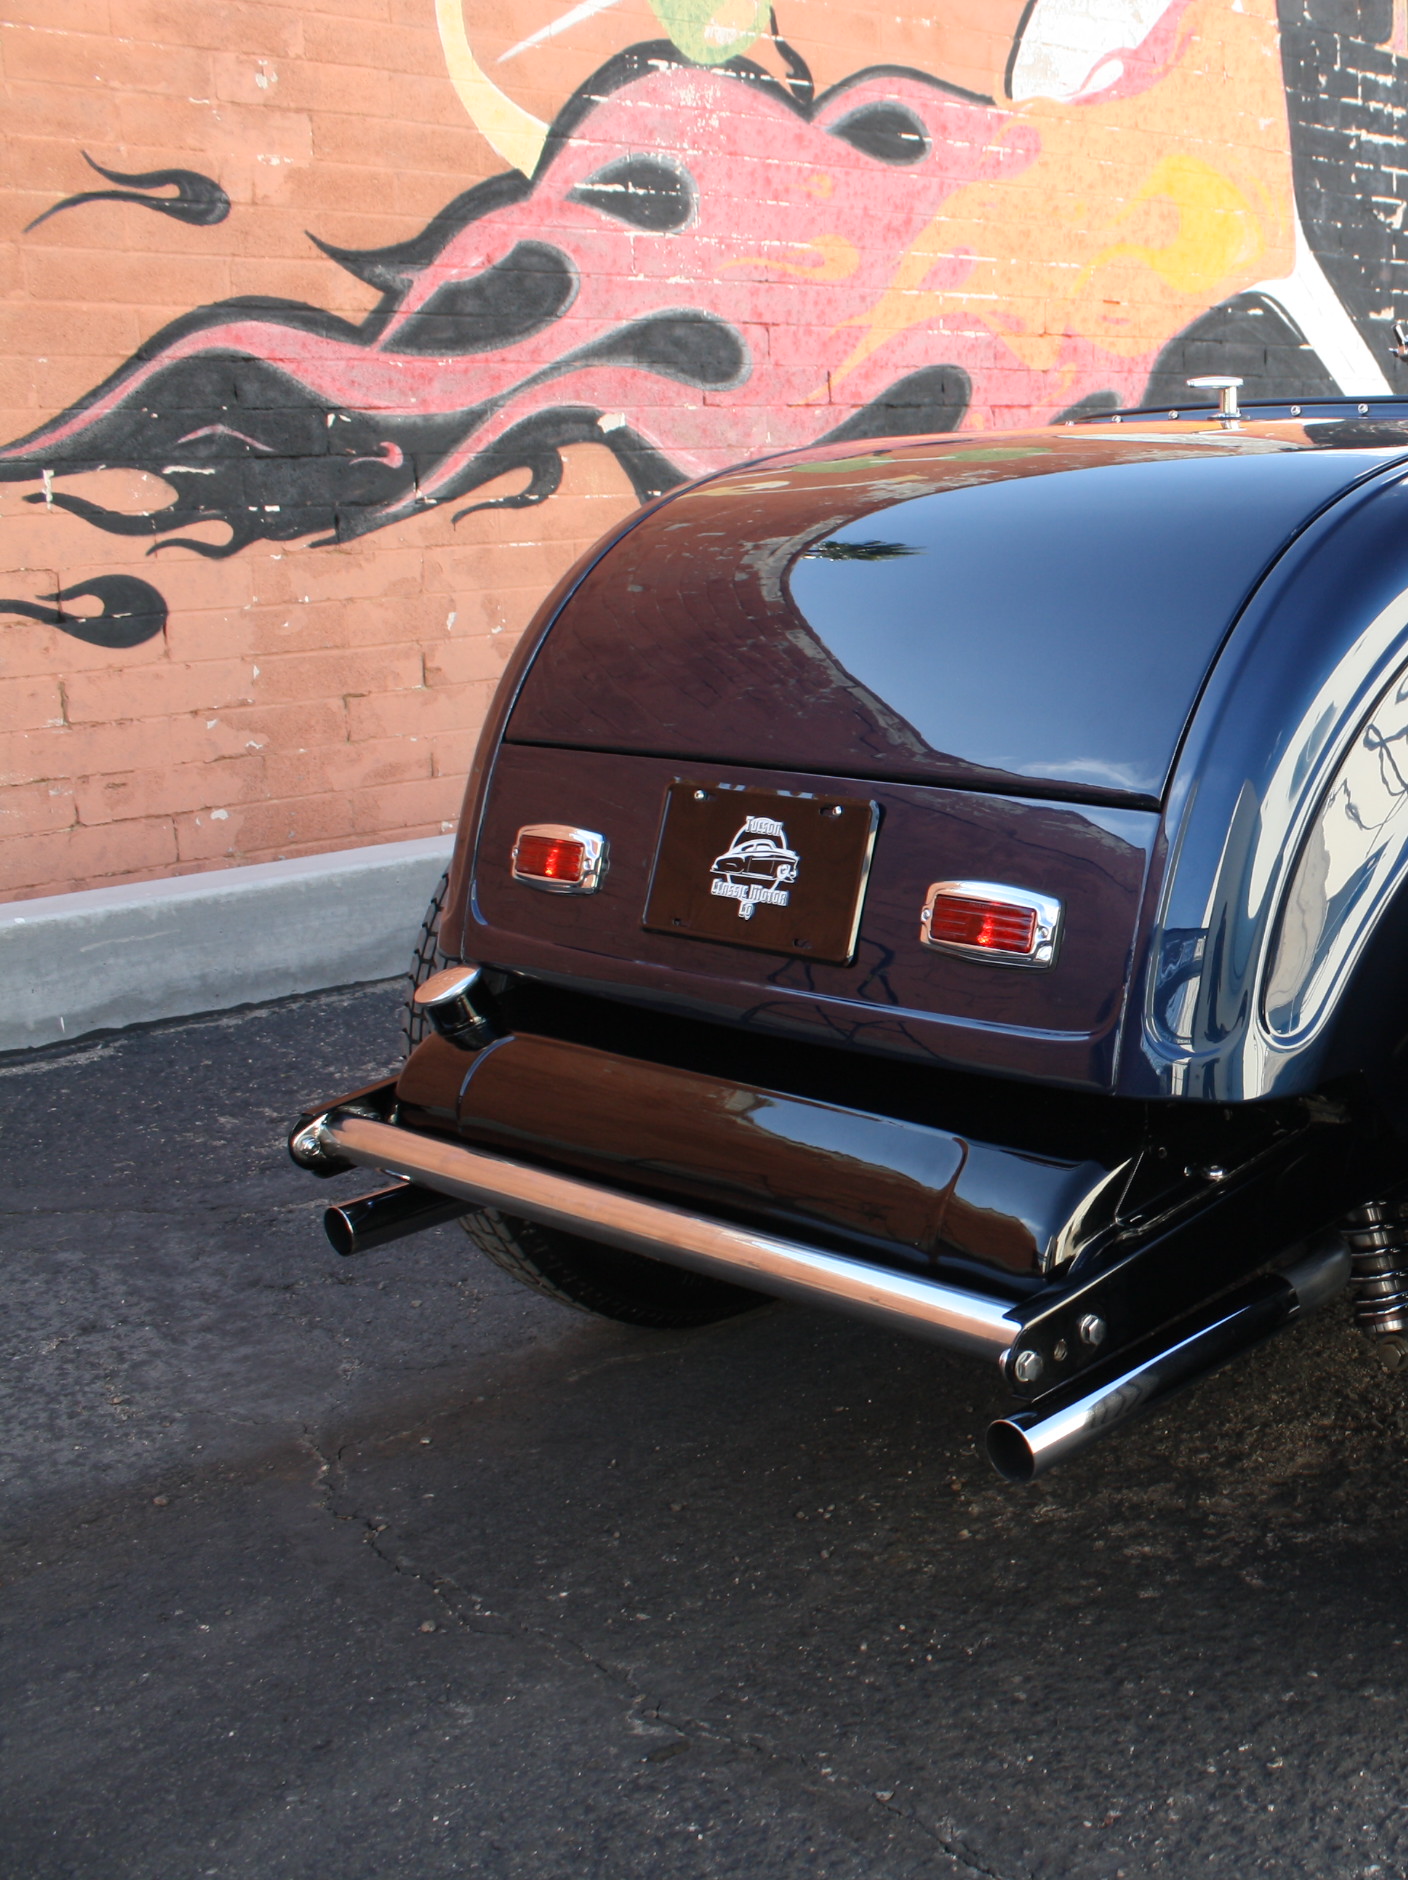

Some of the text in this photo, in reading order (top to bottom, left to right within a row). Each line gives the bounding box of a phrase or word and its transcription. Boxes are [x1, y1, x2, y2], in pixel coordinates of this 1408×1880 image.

[746, 815, 783, 836] TUCSON
[711, 879, 788, 906] CLASSIC MOTOR
[738, 902, 752, 919] CO
